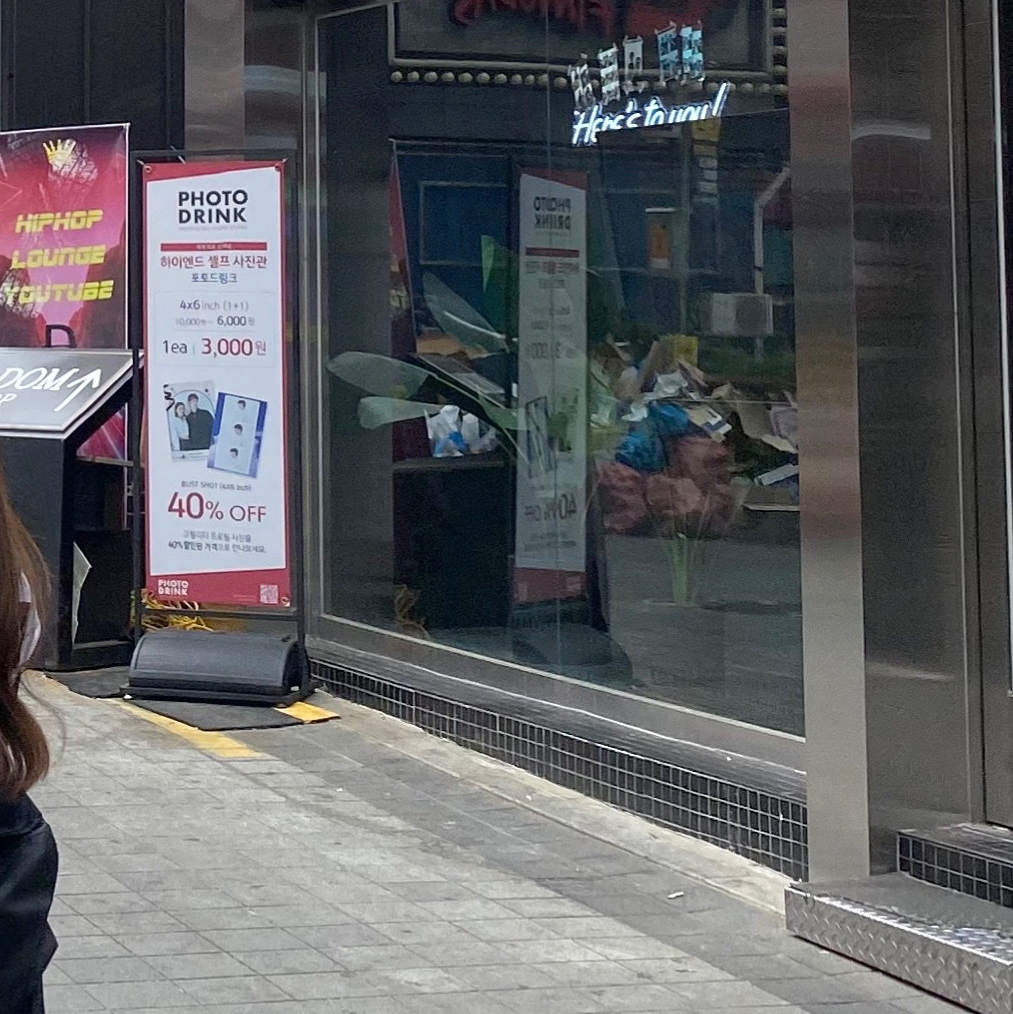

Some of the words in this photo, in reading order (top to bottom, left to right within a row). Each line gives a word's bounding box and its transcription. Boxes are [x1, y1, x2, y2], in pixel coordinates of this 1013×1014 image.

[178, 189, 249, 206] PHOTO
[15, 209, 103, 233] HIPHOP
[178, 207, 248, 224] DRINK
[10, 244, 106, 270] LOUNGE
[160, 255, 205, 269] 하이엔드
[208, 255, 231, 268] 셀프
[233, 255, 267, 269] 사진관
[191, 273, 238, 284] 포토드링크
[5, 280, 114, 306] YOUTUBE
[179, 300, 201, 310] 4x6
[162, 340, 188, 354] 1ea
[168, 492, 224, 520] 40%
[229, 505, 266, 522] OFF
[158, 579, 189, 588] PHOTO
[158, 587, 188, 596] DRINK
